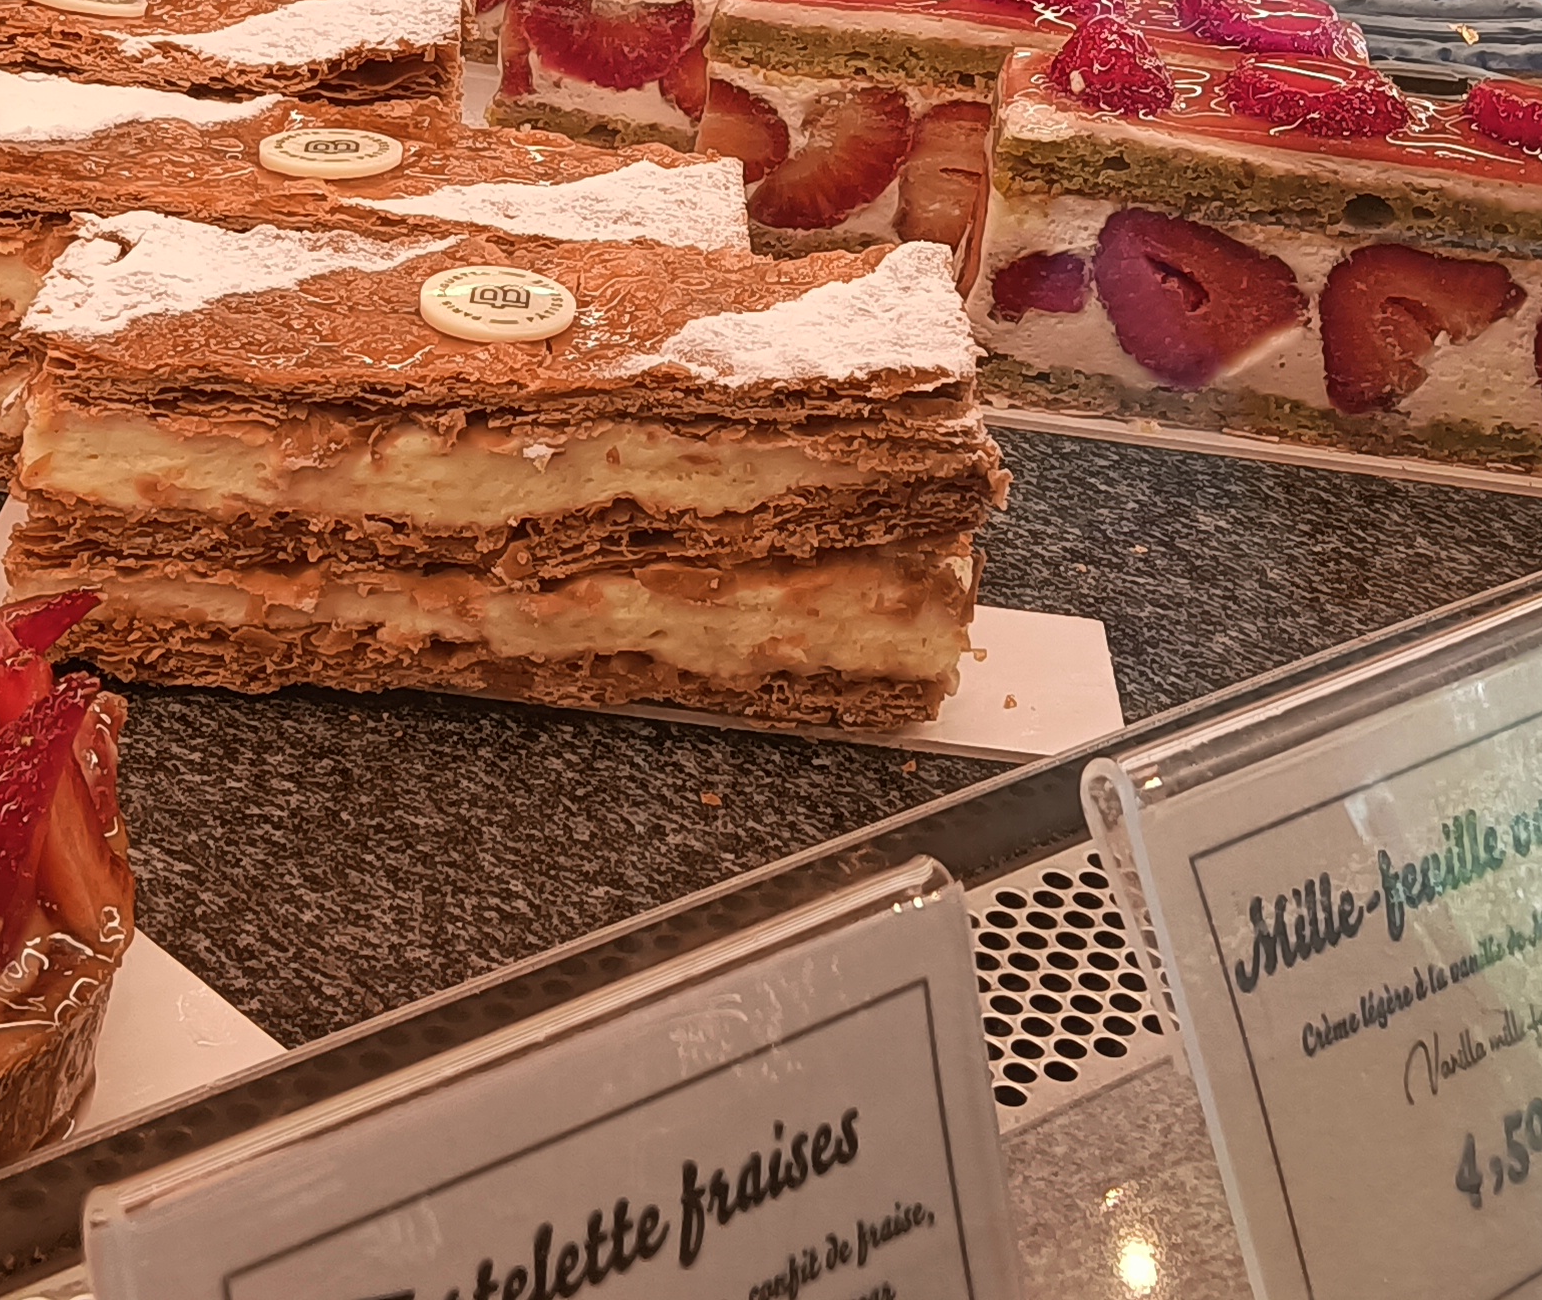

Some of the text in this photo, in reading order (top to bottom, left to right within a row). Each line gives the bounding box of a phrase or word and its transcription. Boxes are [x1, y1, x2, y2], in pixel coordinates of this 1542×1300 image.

[1234, 809, 1506, 993] Mille-feuille
[1302, 1012, 1359, 1057] Crème
[1360, 982, 1413, 1029] légère
[1412, 966, 1428, 1000] à
[1428, 963, 1448, 993] la
[354, 1107, 859, 1300] telette fraises
[825, 1231, 853, 1270] de
[856, 1201, 935, 1267] fraise,
